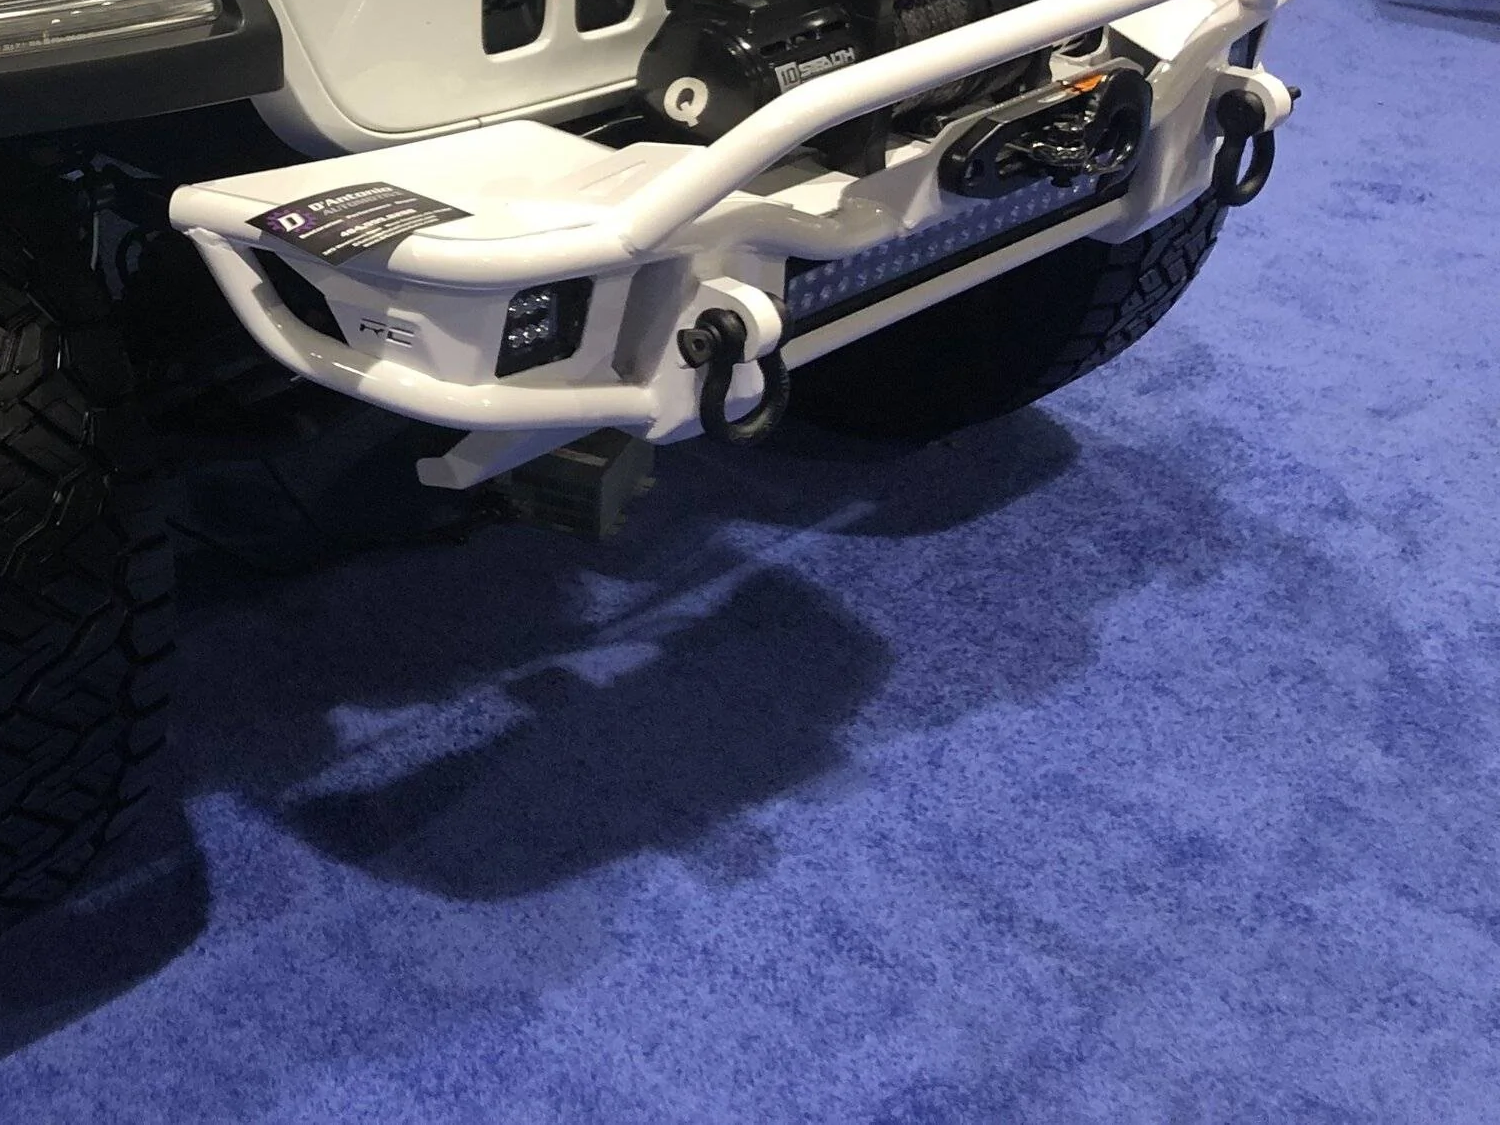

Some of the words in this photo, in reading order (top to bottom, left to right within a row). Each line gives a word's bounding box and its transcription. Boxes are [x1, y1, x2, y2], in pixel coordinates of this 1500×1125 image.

[663, 76, 709, 128] Q
[307, 186, 395, 213] D'Antonio
[277, 212, 307, 233] D
